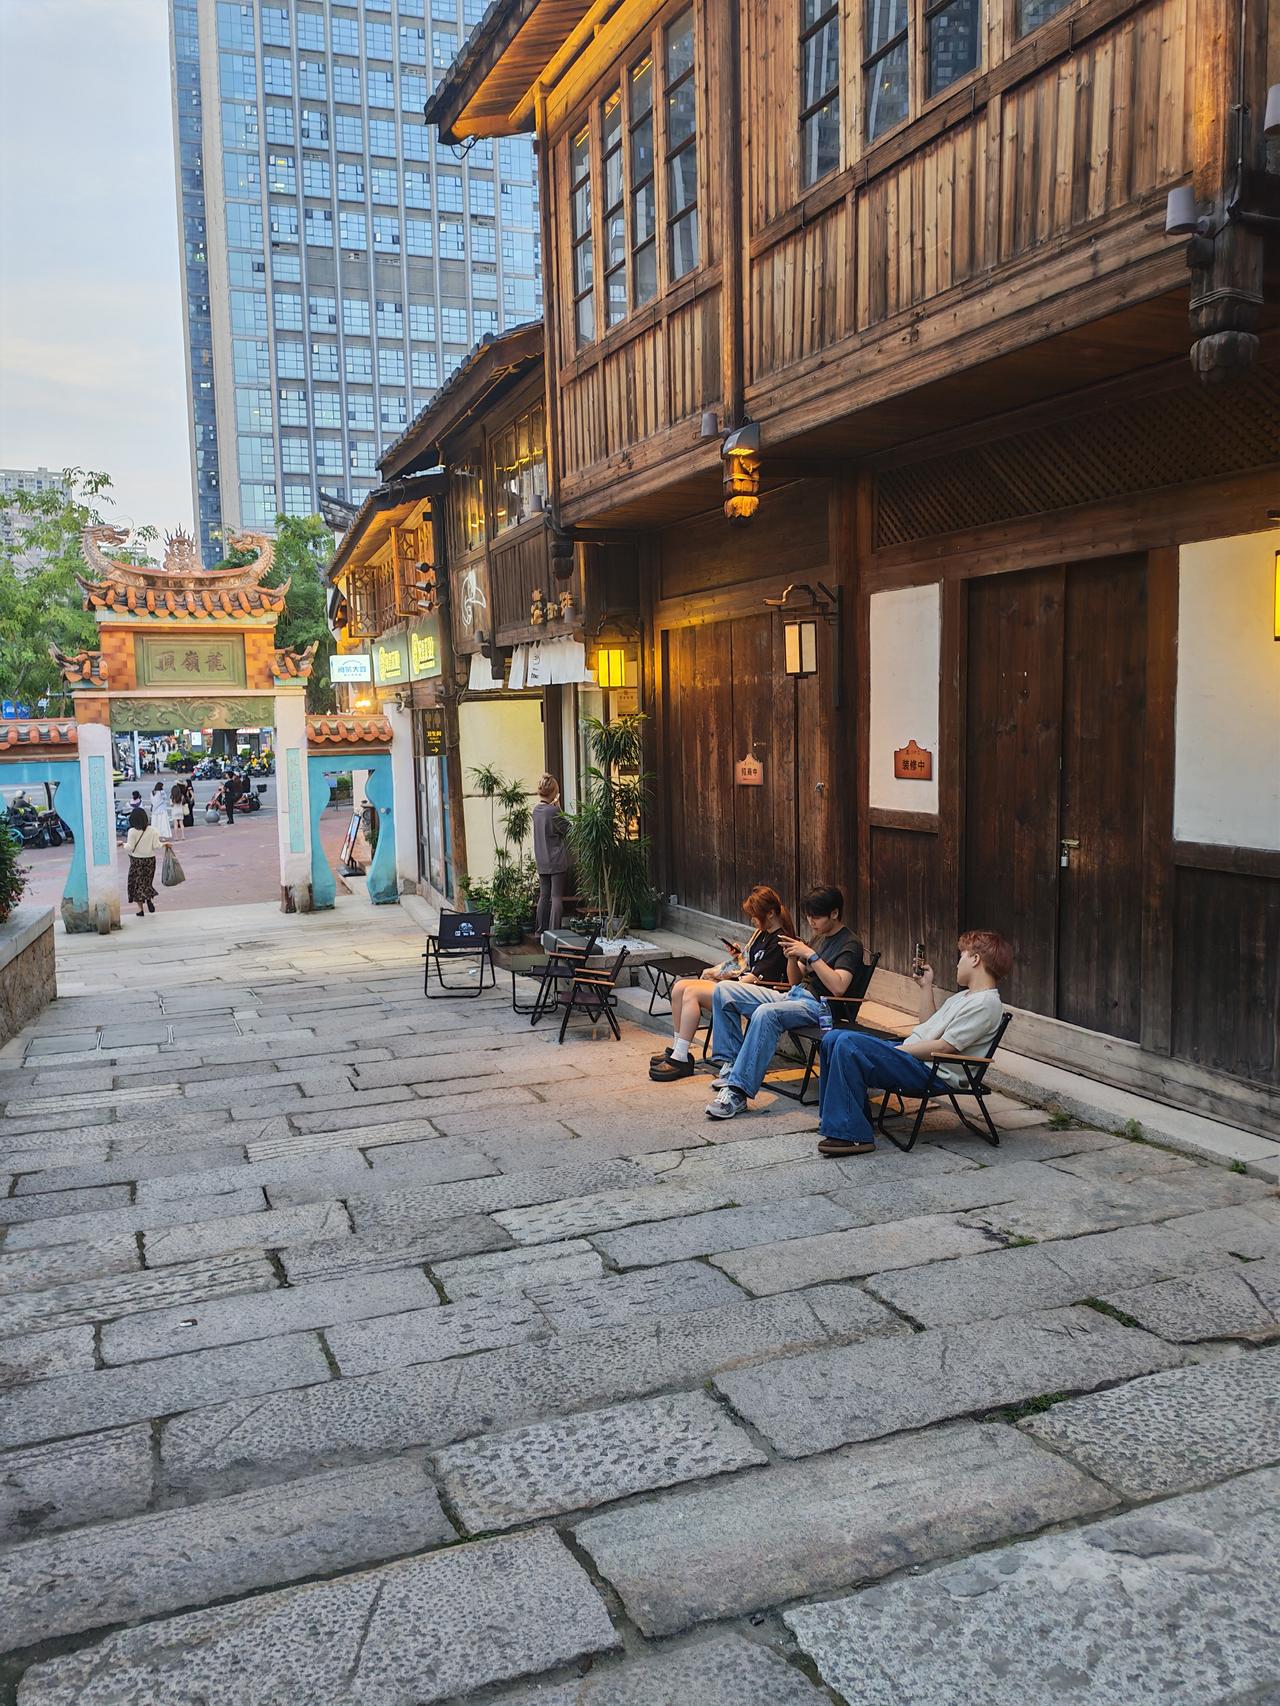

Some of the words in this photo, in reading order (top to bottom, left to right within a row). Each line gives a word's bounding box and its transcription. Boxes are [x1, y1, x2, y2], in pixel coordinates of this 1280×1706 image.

[154, 650, 227, 672] 龍嶺頂
[902, 759, 925, 771] 装修中
